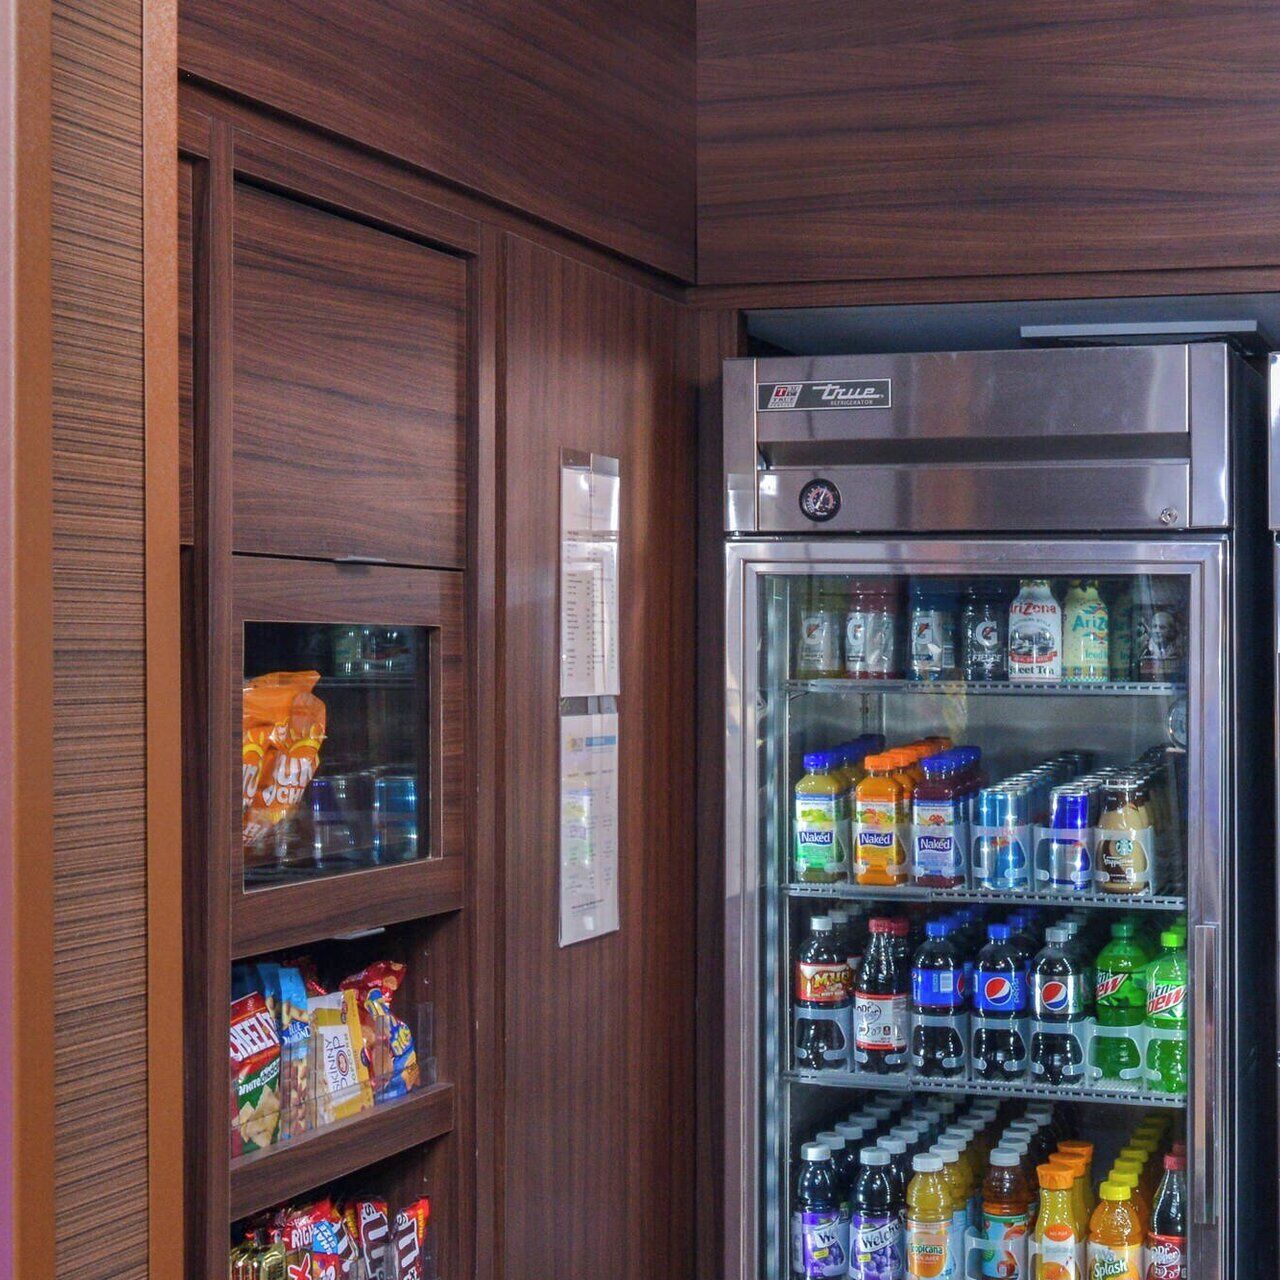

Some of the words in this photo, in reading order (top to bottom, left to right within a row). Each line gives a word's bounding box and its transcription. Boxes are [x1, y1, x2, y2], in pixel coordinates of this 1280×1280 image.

[801, 831, 831, 843] Naked
[861, 834, 891, 845] Naked
[920, 838, 951, 850] Naked
[1094, 1259, 1128, 1280] Splash
